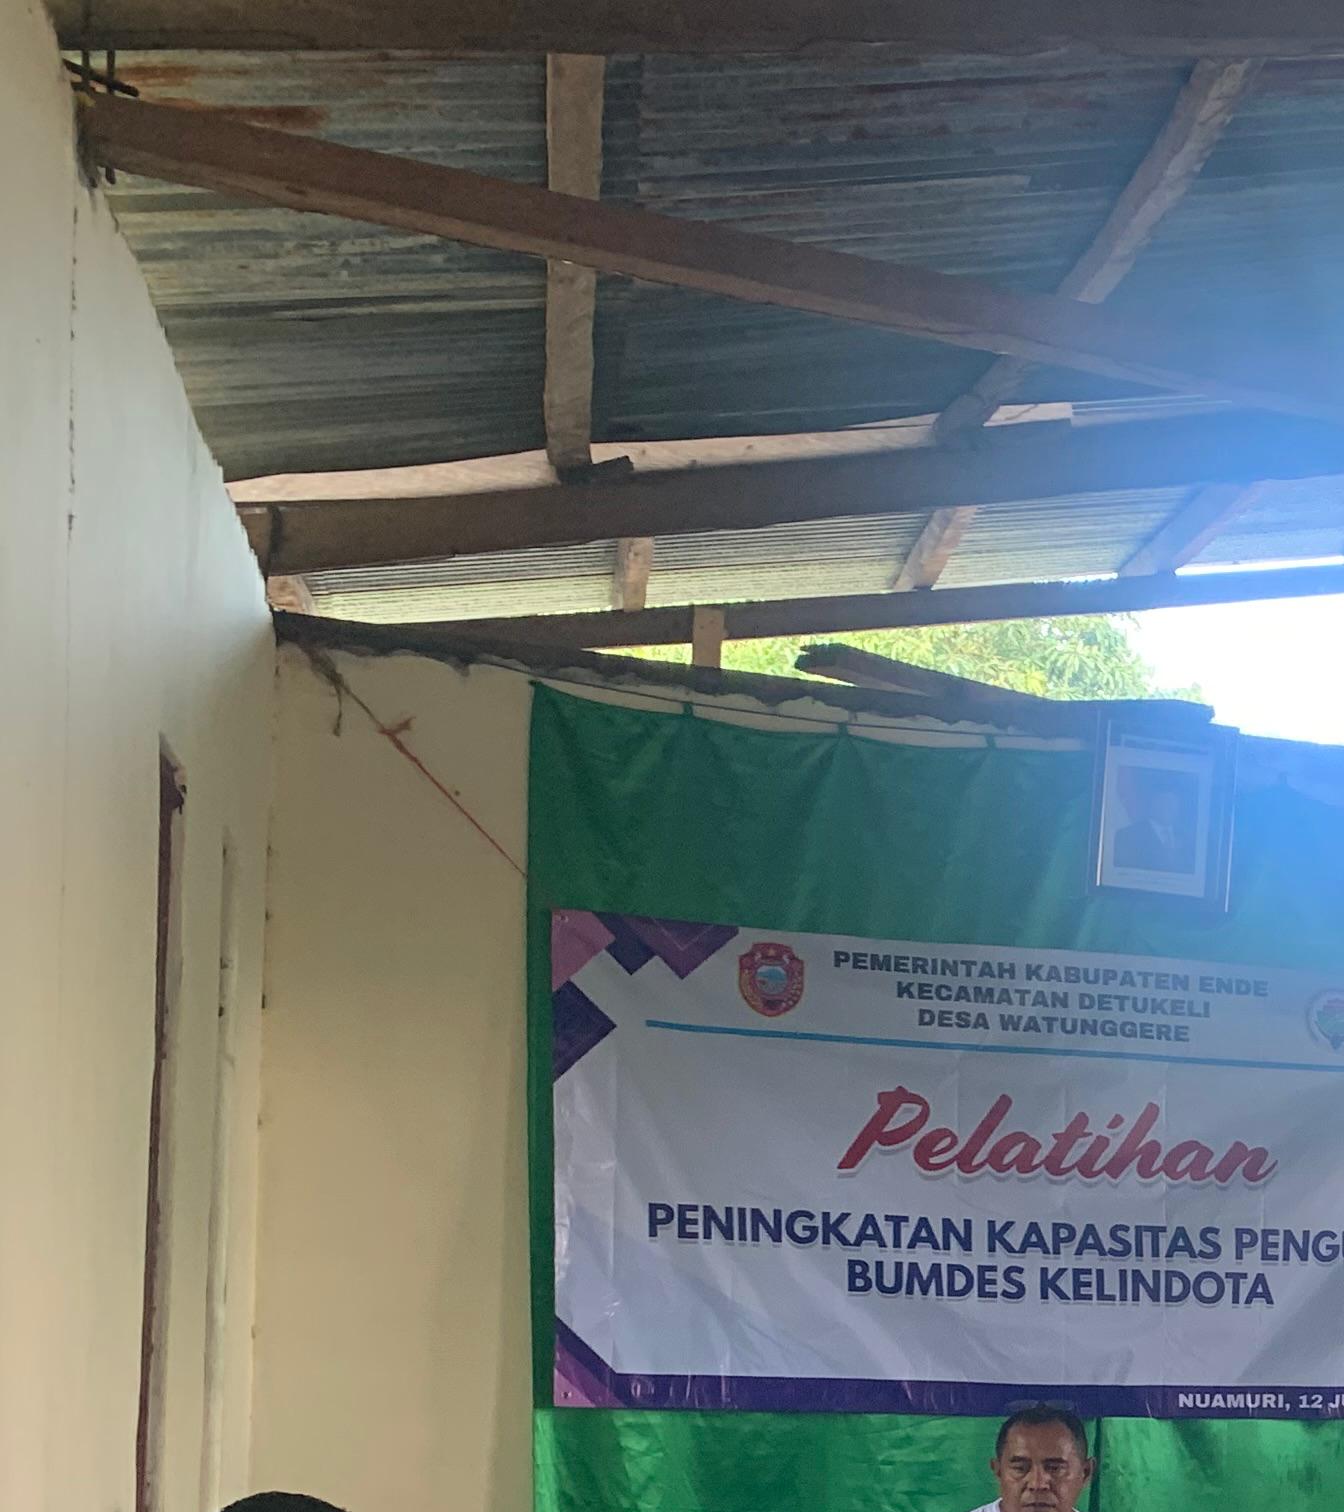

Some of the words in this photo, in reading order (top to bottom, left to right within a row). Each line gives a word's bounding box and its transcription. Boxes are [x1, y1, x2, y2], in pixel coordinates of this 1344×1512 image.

[833, 950, 1016, 980] PEMERINTAH
[1025, 963, 1190, 991] KABUPATEN
[1199, 975, 1269, 997] ENDE
[896, 981, 1069, 1009] KECAMATAN
[1079, 992, 1211, 1018] DETUKELI
[918, 1008, 990, 1029] DESA
[999, 1013, 1190, 1042] WATUNGGERE
[837, 1086, 1278, 1183] Pelatihan
[648, 1202, 972, 1252] PENINGKATAN
[988, 1220, 1222, 1260] KAPASITAS
[847, 1259, 1025, 1299] BUMDES
[1040, 1267, 1274, 1305] KELINDOTA
[1178, 1393, 1291, 1411] NUAMURI,
[1299, 1394, 1323, 1409] 12
